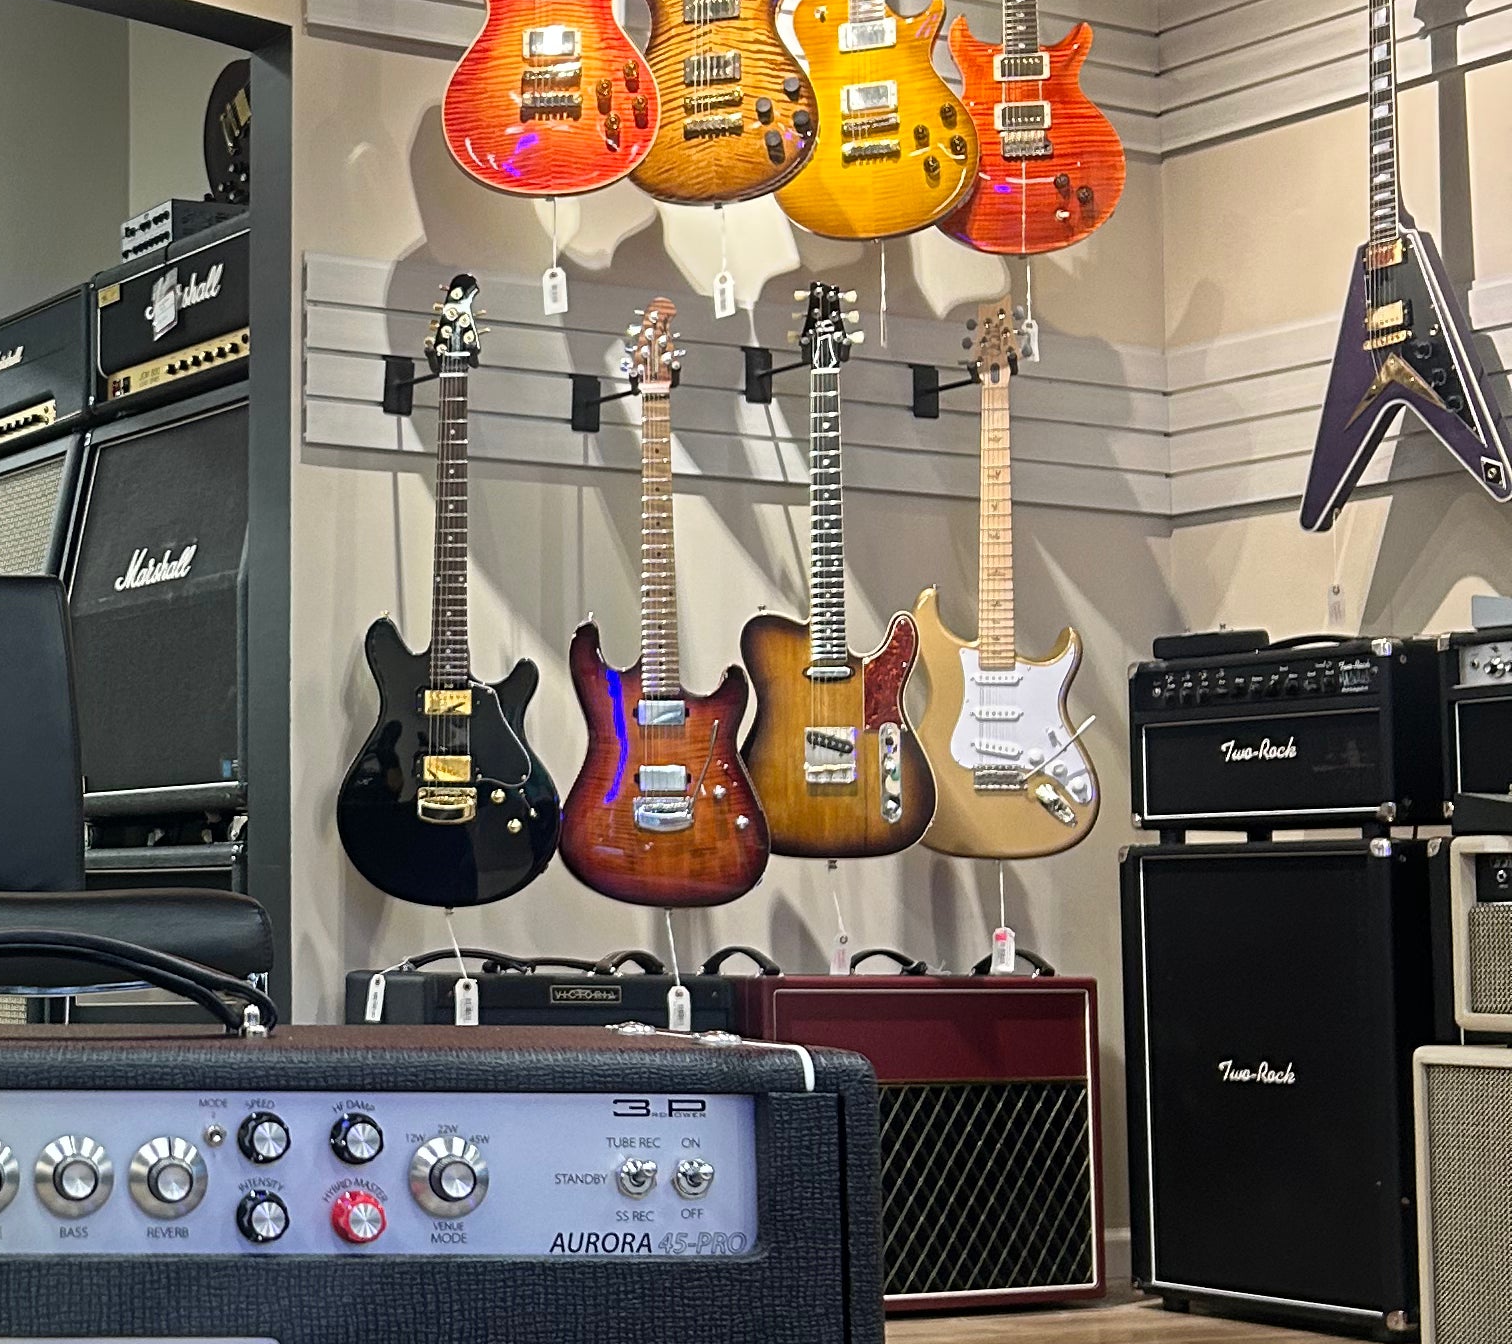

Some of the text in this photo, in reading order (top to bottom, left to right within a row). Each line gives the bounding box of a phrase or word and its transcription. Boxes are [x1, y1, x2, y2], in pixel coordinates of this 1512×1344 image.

[114, 544, 198, 592] Marshall
[1220, 736, 1298, 763] Two-Rock
[554, 989, 616, 1000] VICTORIA
[1218, 1060, 1296, 1086] Two-Rock
[198, 1098, 228, 1108] MODE
[244, 1098, 276, 1110] SPEED
[437, 1124, 458, 1134] 22W
[405, 1133, 426, 1143] 12W
[468, 1134, 490, 1144] 45W
[606, 1137, 661, 1149] TUBE REC
[681, 1137, 701, 1149] ON
[238, 1177, 284, 1192] INTENSITY
[554, 1173, 608, 1185] STANDBY
[353, 1177, 388, 1202] MASTER
[615, 1211, 656, 1222] SS REC
[681, 1208, 705, 1219] OFF
[59, 1226, 88, 1239] BASS
[146, 1226, 190, 1239] REVERB
[432, 1221, 465, 1232] VENUE
[430, 1233, 468, 1244] MODE
[549, 1231, 748, 1254] AURORA 45-PRO
